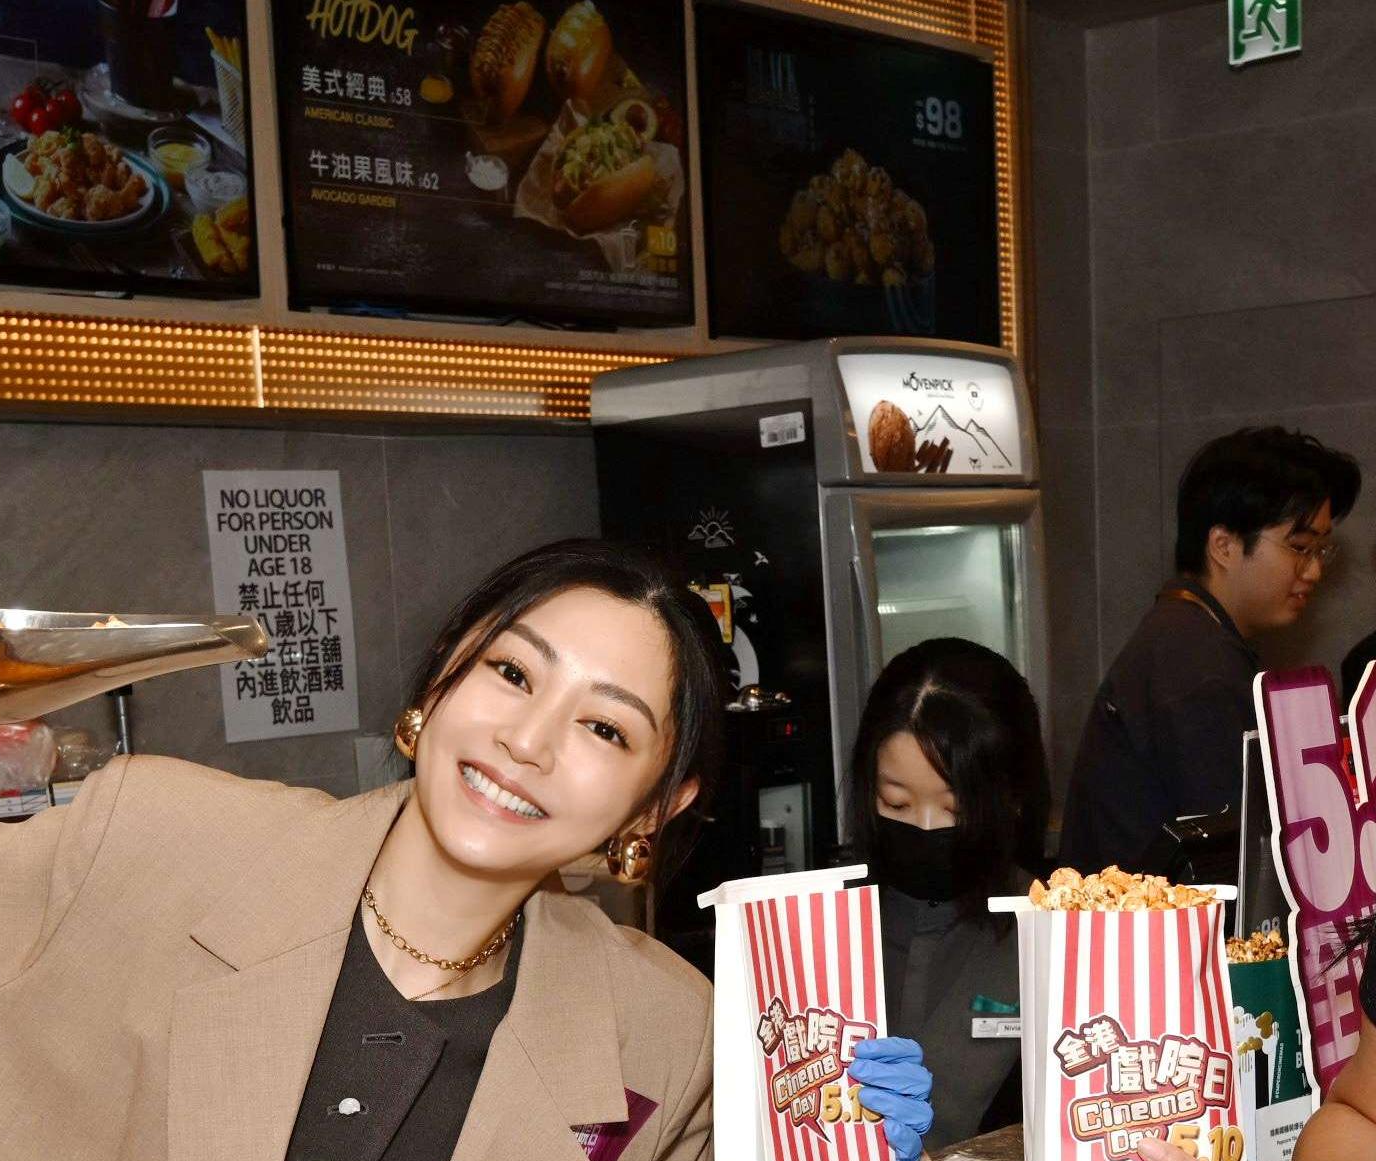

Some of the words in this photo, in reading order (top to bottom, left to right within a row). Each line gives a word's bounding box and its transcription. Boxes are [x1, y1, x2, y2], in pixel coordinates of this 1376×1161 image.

[306, 0, 419, 56] HOTDOG
[302, 65, 386, 103] 美式經典
[309, 149, 416, 188] 牛油果風味
[220, 489, 251, 509] NO
[254, 488, 327, 511] LIQUOR
[217, 513, 256, 532] FOR
[258, 511, 334, 531] PERSON
[244, 534, 312, 554] UNDER
[247, 557, 286, 577] AGE
[290, 556, 313, 576] 18
[238, 580, 326, 611] 禁止任何
[238, 608, 338, 638] 八歲以下
[271, 695, 315, 725] 飲品
[1056, 1020, 1229, 1102] 全港戲院日
[775, 1056, 838, 1102] Cinema
[792, 1093, 818, 1122] Day
[1076, 1089, 1198, 1132] Cinema
